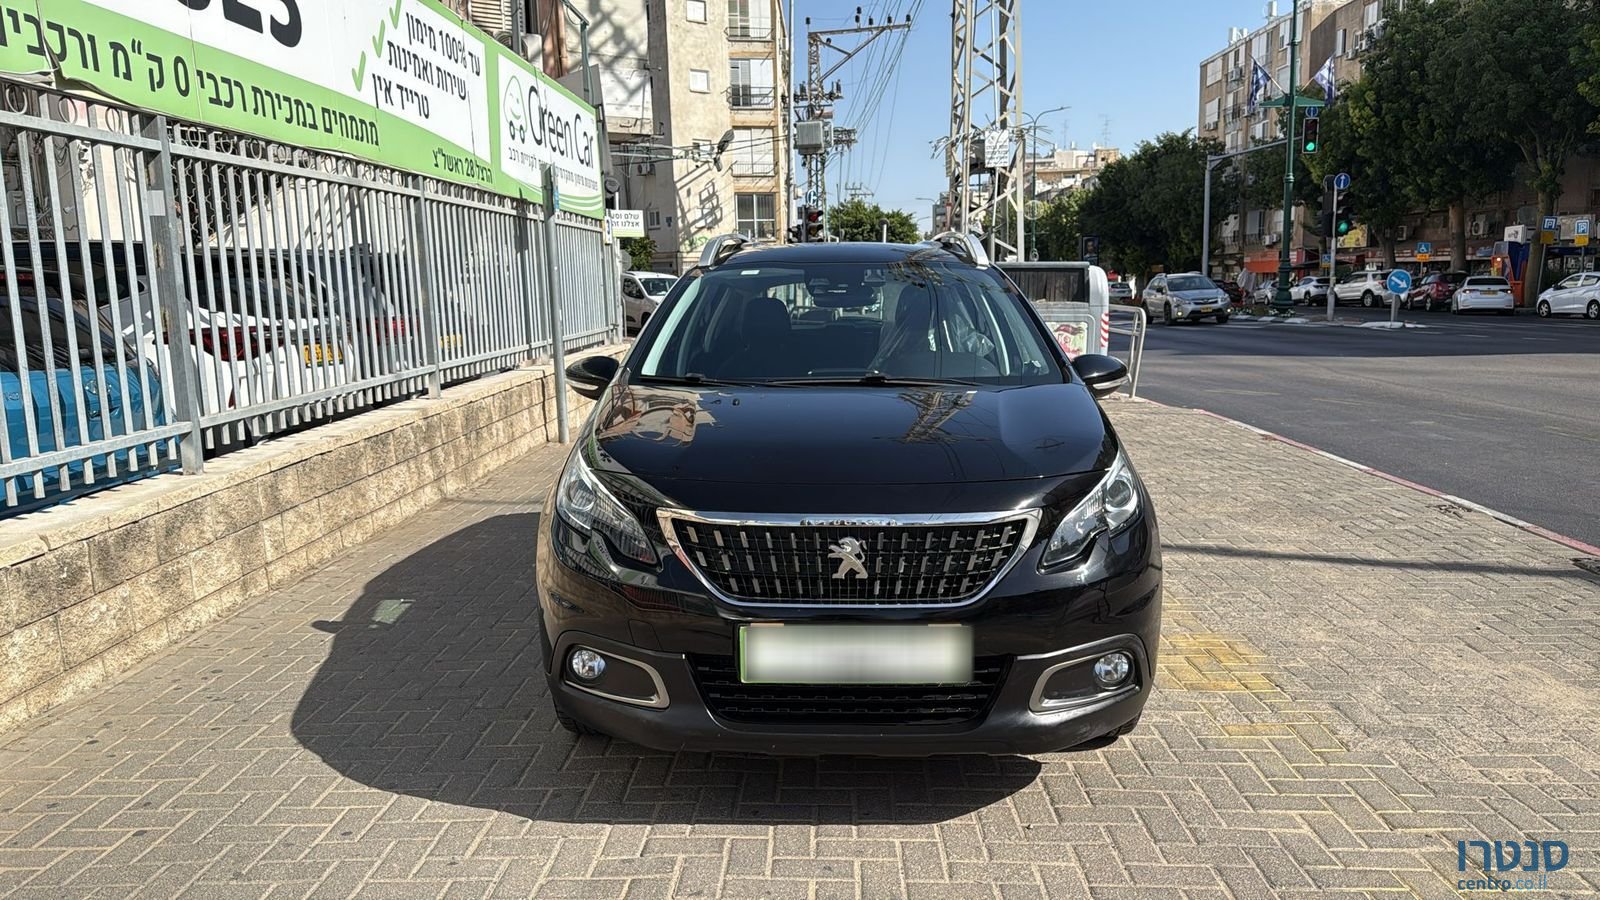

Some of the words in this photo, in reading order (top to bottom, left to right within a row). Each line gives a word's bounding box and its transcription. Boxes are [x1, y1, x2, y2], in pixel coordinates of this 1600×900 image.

[406, 12, 436, 51] מימון
[439, 30, 467, 69] 100%
[174, 56, 190, 97] 0
[387, 40, 434, 85] ואמינות
[468, 51, 480, 76] עד
[196, 69, 247, 112] רכבי
[372, 73, 394, 109] אין
[396, 83, 429, 119] טרייד
[436, 66, 466, 100] שירות
[251, 85, 319, 130] במכירת
[320, 106, 379, 146] מתמחים
[528, 86, 574, 161] Green
[574, 113, 594, 169] Car
[464, 158, 475, 178] 28
